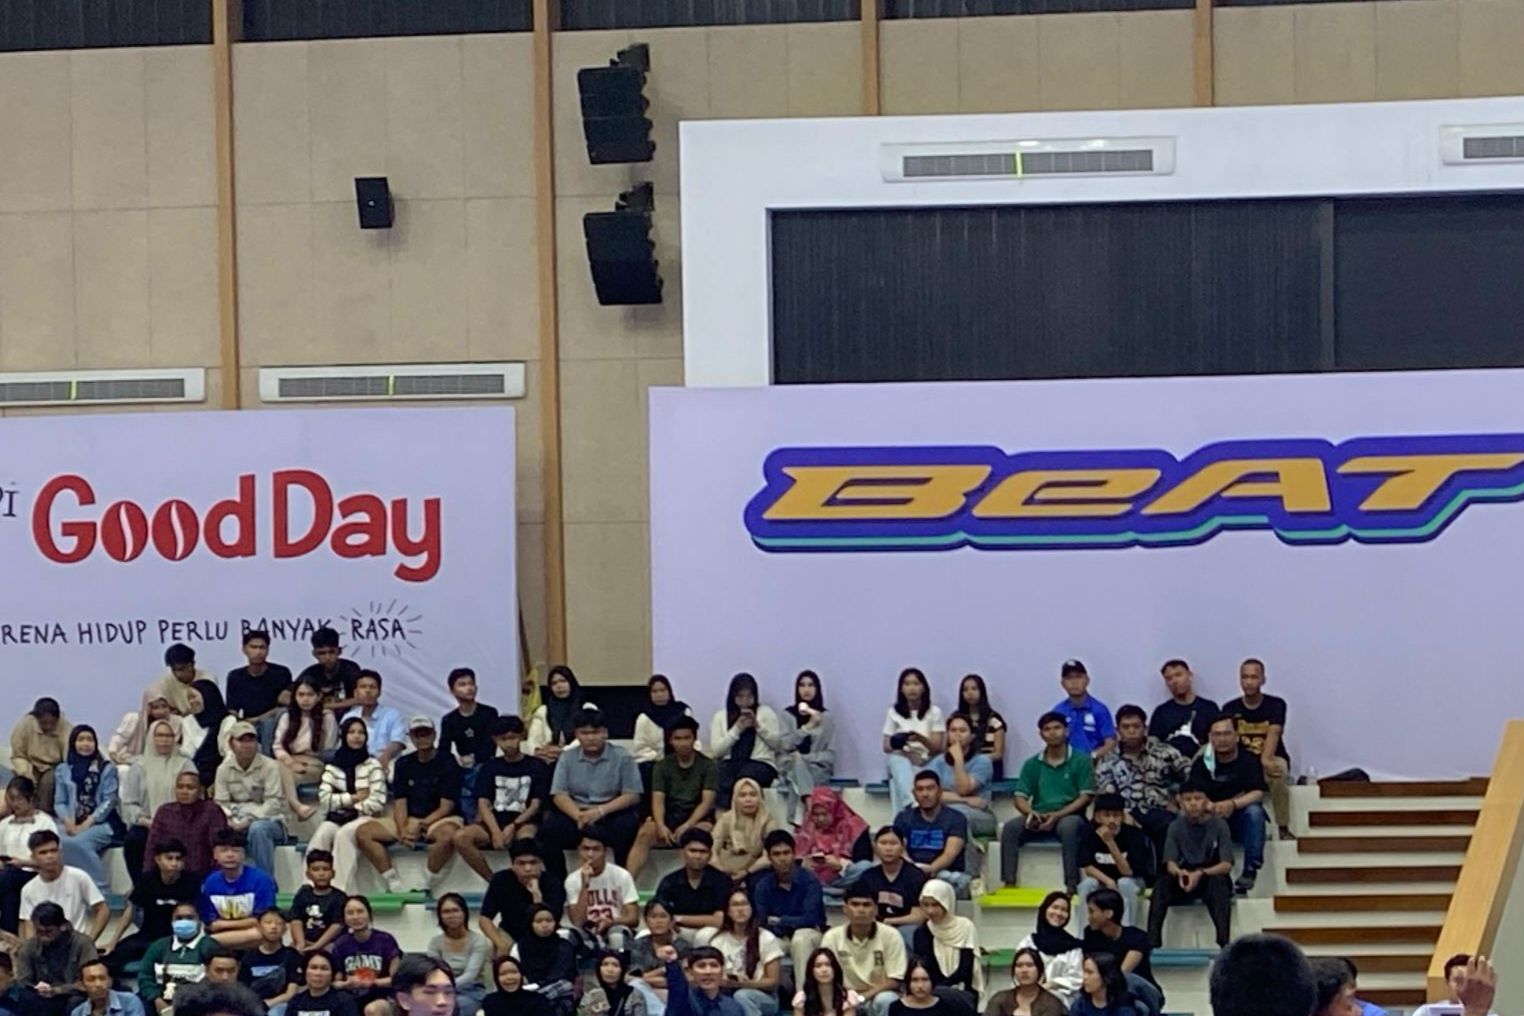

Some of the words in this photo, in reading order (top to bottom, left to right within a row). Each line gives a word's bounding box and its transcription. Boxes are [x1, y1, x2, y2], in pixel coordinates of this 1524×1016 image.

[32, 474, 257, 564] Good
[272, 469, 442, 583] Day
[77, 620, 147, 645] HIDUP
[159, 618, 229, 642] PERLU
[351, 618, 407, 641] RASA
